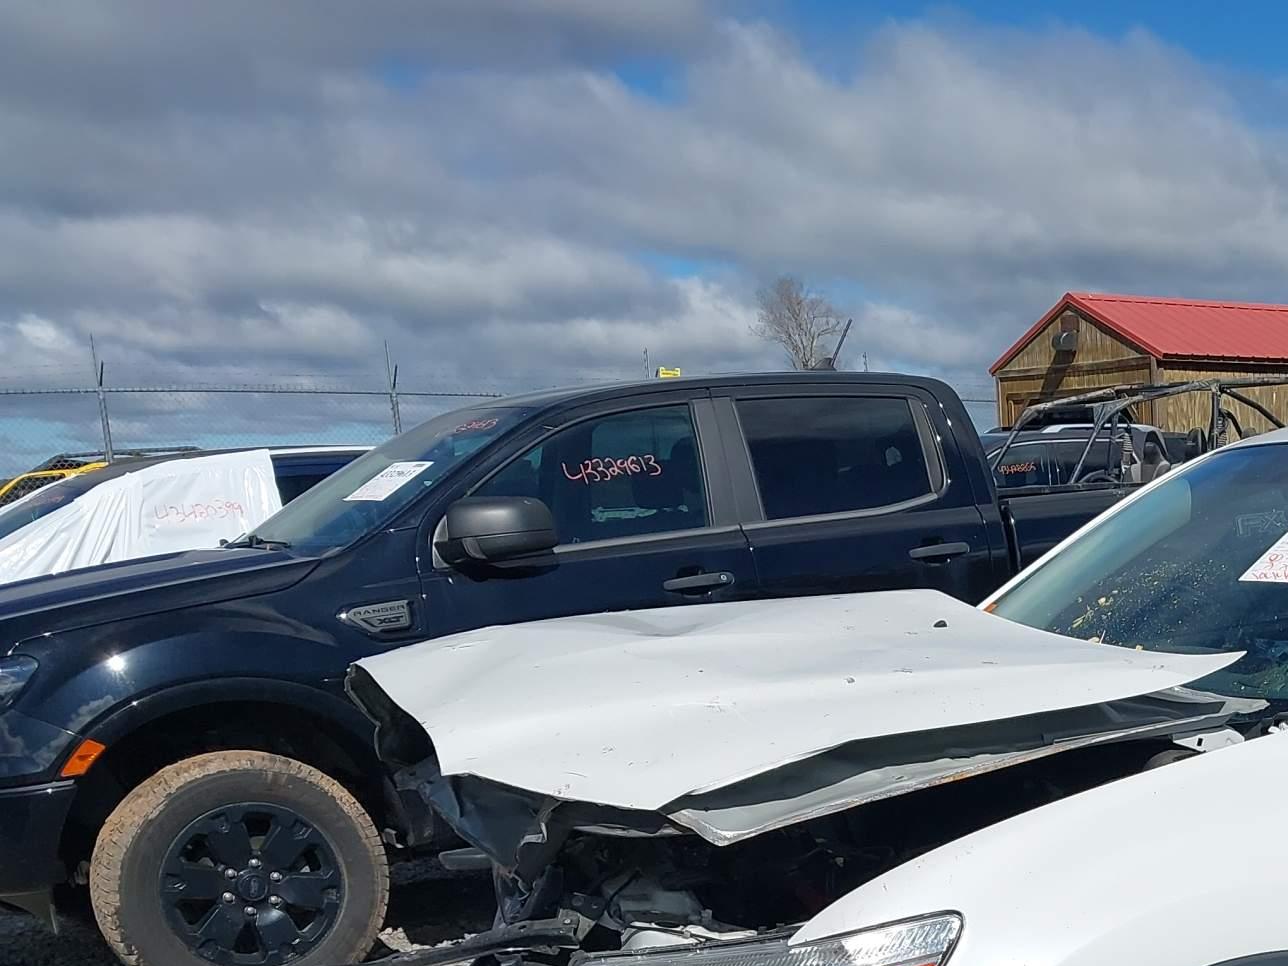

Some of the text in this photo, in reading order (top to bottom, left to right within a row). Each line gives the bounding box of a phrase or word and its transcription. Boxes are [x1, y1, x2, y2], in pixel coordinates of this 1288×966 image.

[561, 454, 662, 485] 43329613
[353, 604, 405, 617] RANGER
[376, 615, 404, 625] XLT
